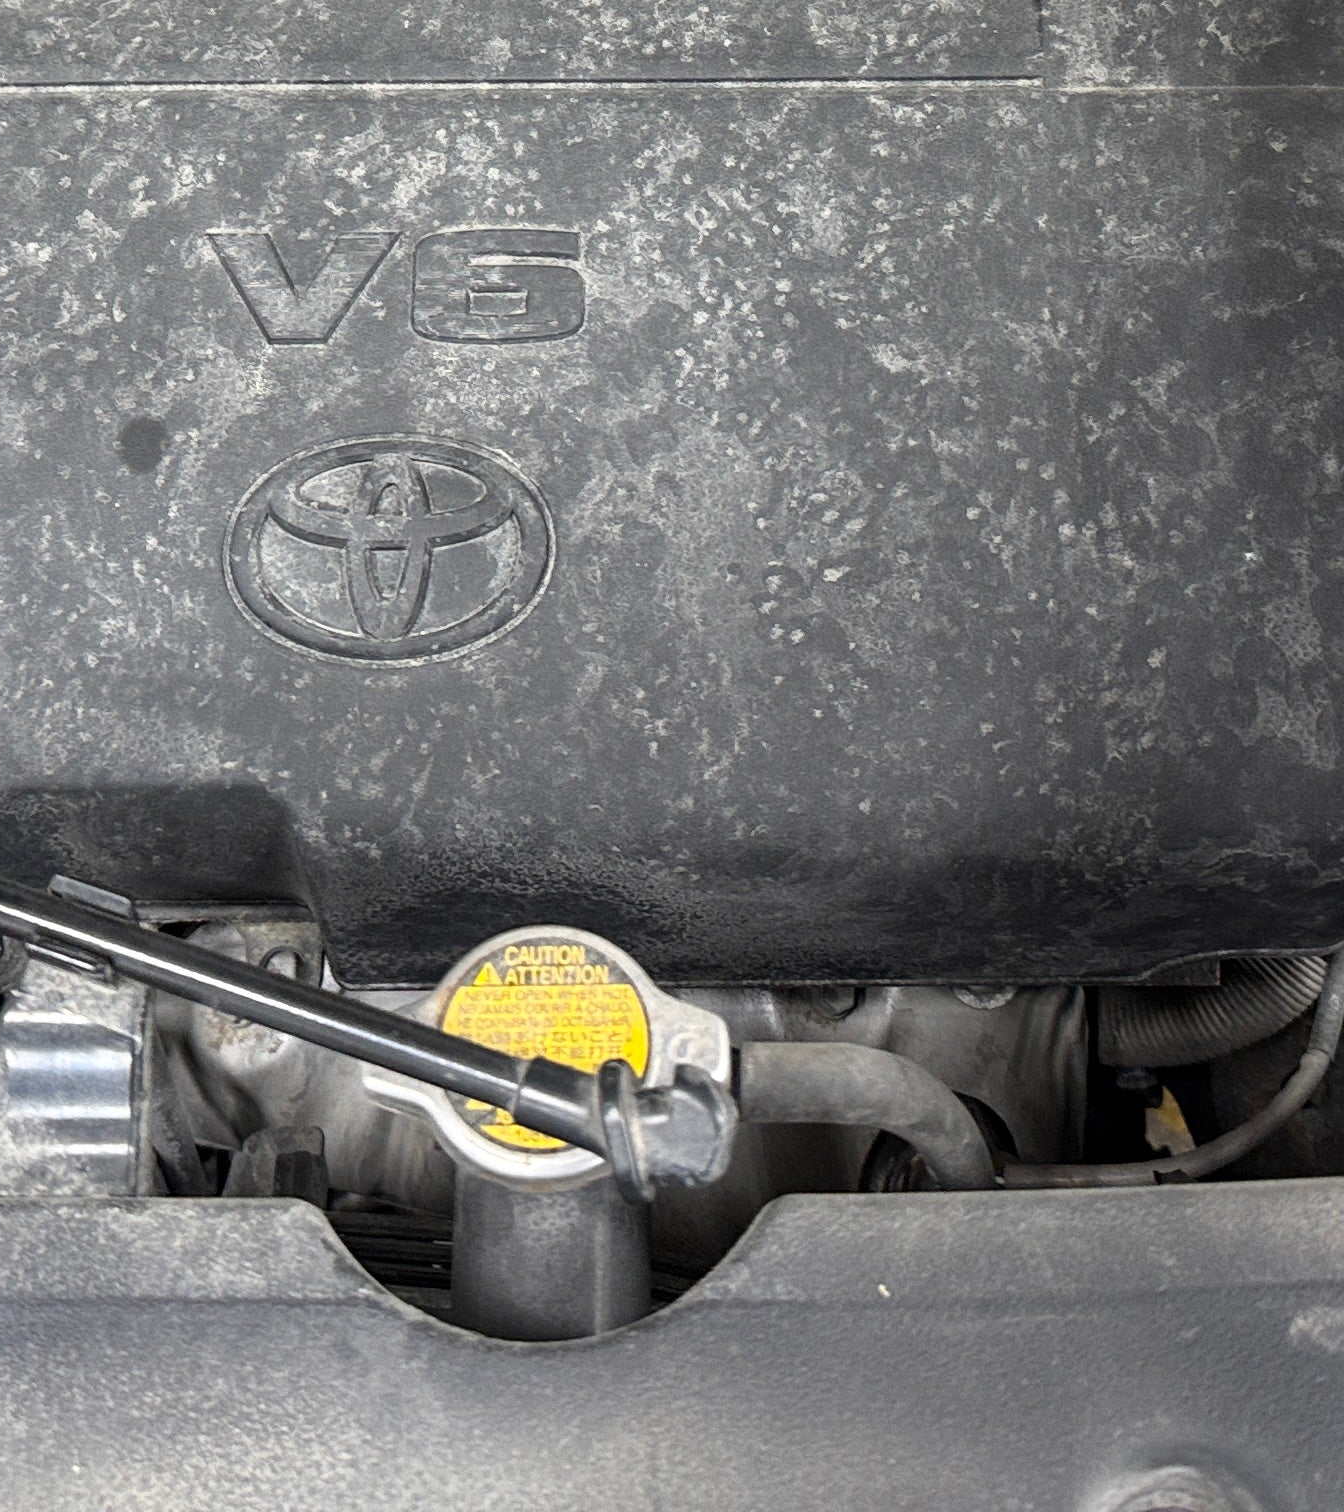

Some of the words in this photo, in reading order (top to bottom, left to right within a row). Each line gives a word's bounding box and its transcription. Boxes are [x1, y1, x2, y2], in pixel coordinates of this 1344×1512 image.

[205, 228, 586, 345] V6
[504, 945, 586, 965] CAUTION
[504, 965, 609, 985] ATTENTION
[464, 989, 511, 1001] NEVER
[515, 989, 553, 1001] OPEN
